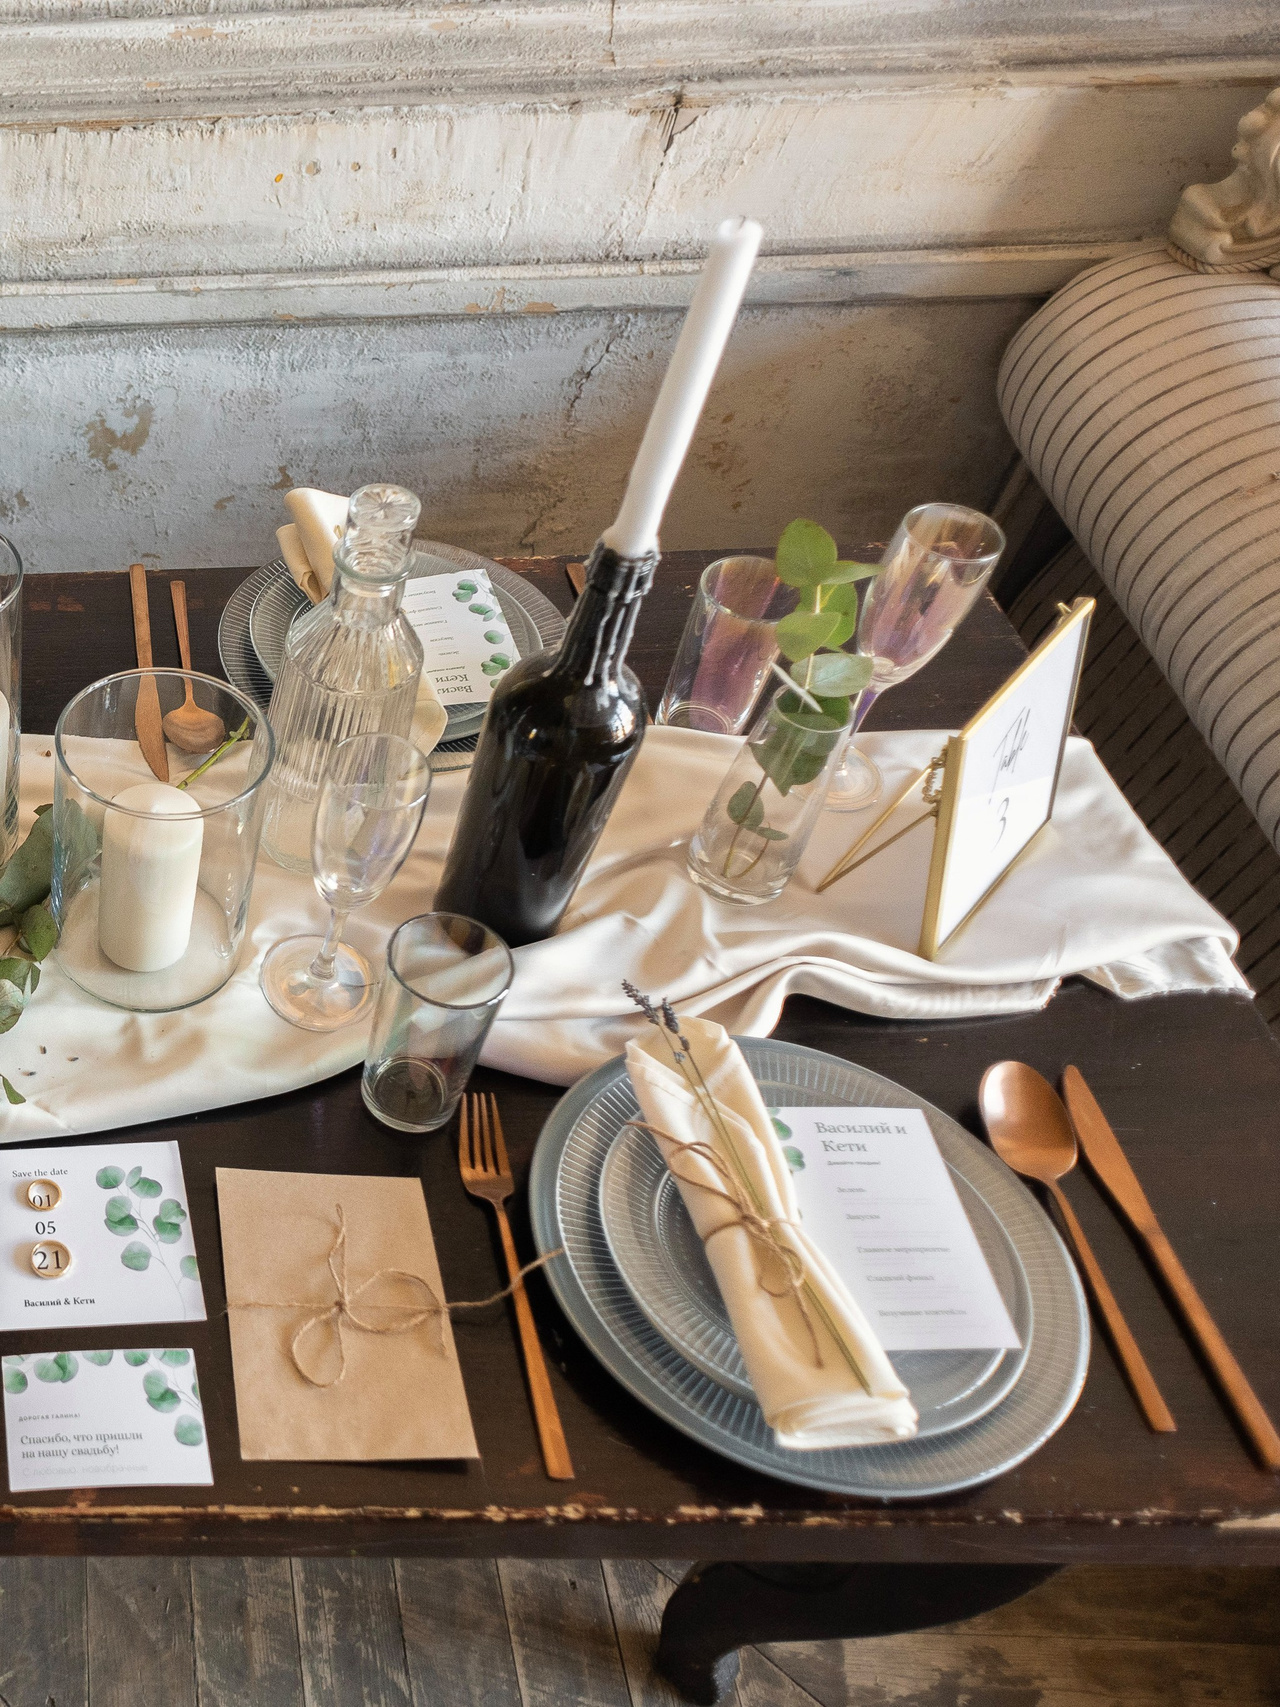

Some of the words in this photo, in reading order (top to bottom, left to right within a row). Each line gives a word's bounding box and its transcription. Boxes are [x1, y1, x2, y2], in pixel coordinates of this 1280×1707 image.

[435, 674, 469, 683] Кети
[437, 685, 474, 695] Васи
[991, 797, 1010, 853] 3
[814, 1121, 892, 1134] Василий
[894, 1125, 908, 1135] и
[821, 1140, 868, 1152] Кети
[12, 1170, 32, 1178] Save
[34, 1169, 48, 1177] the
[50, 1168, 68, 1176] date
[33, 1194, 51, 1208] 01
[35, 1220, 56, 1235] 05
[34, 1250, 63, 1270] 21
[24, 1298, 61, 1307] Василий
[63, 1297, 71, 1305] &
[73, 1296, 95, 1305] Кети
[19, 1414, 50, 1422] ДОРОГАЯ
[20, 1433, 71, 1445] Спасибо,
[73, 1434, 93, 1442] что
[95, 1432, 143, 1443] пришли
[21, 1451, 36, 1459] на
[38, 1449, 69, 1459] нашу
[71, 1444, 120, 1457] свадьбу!
